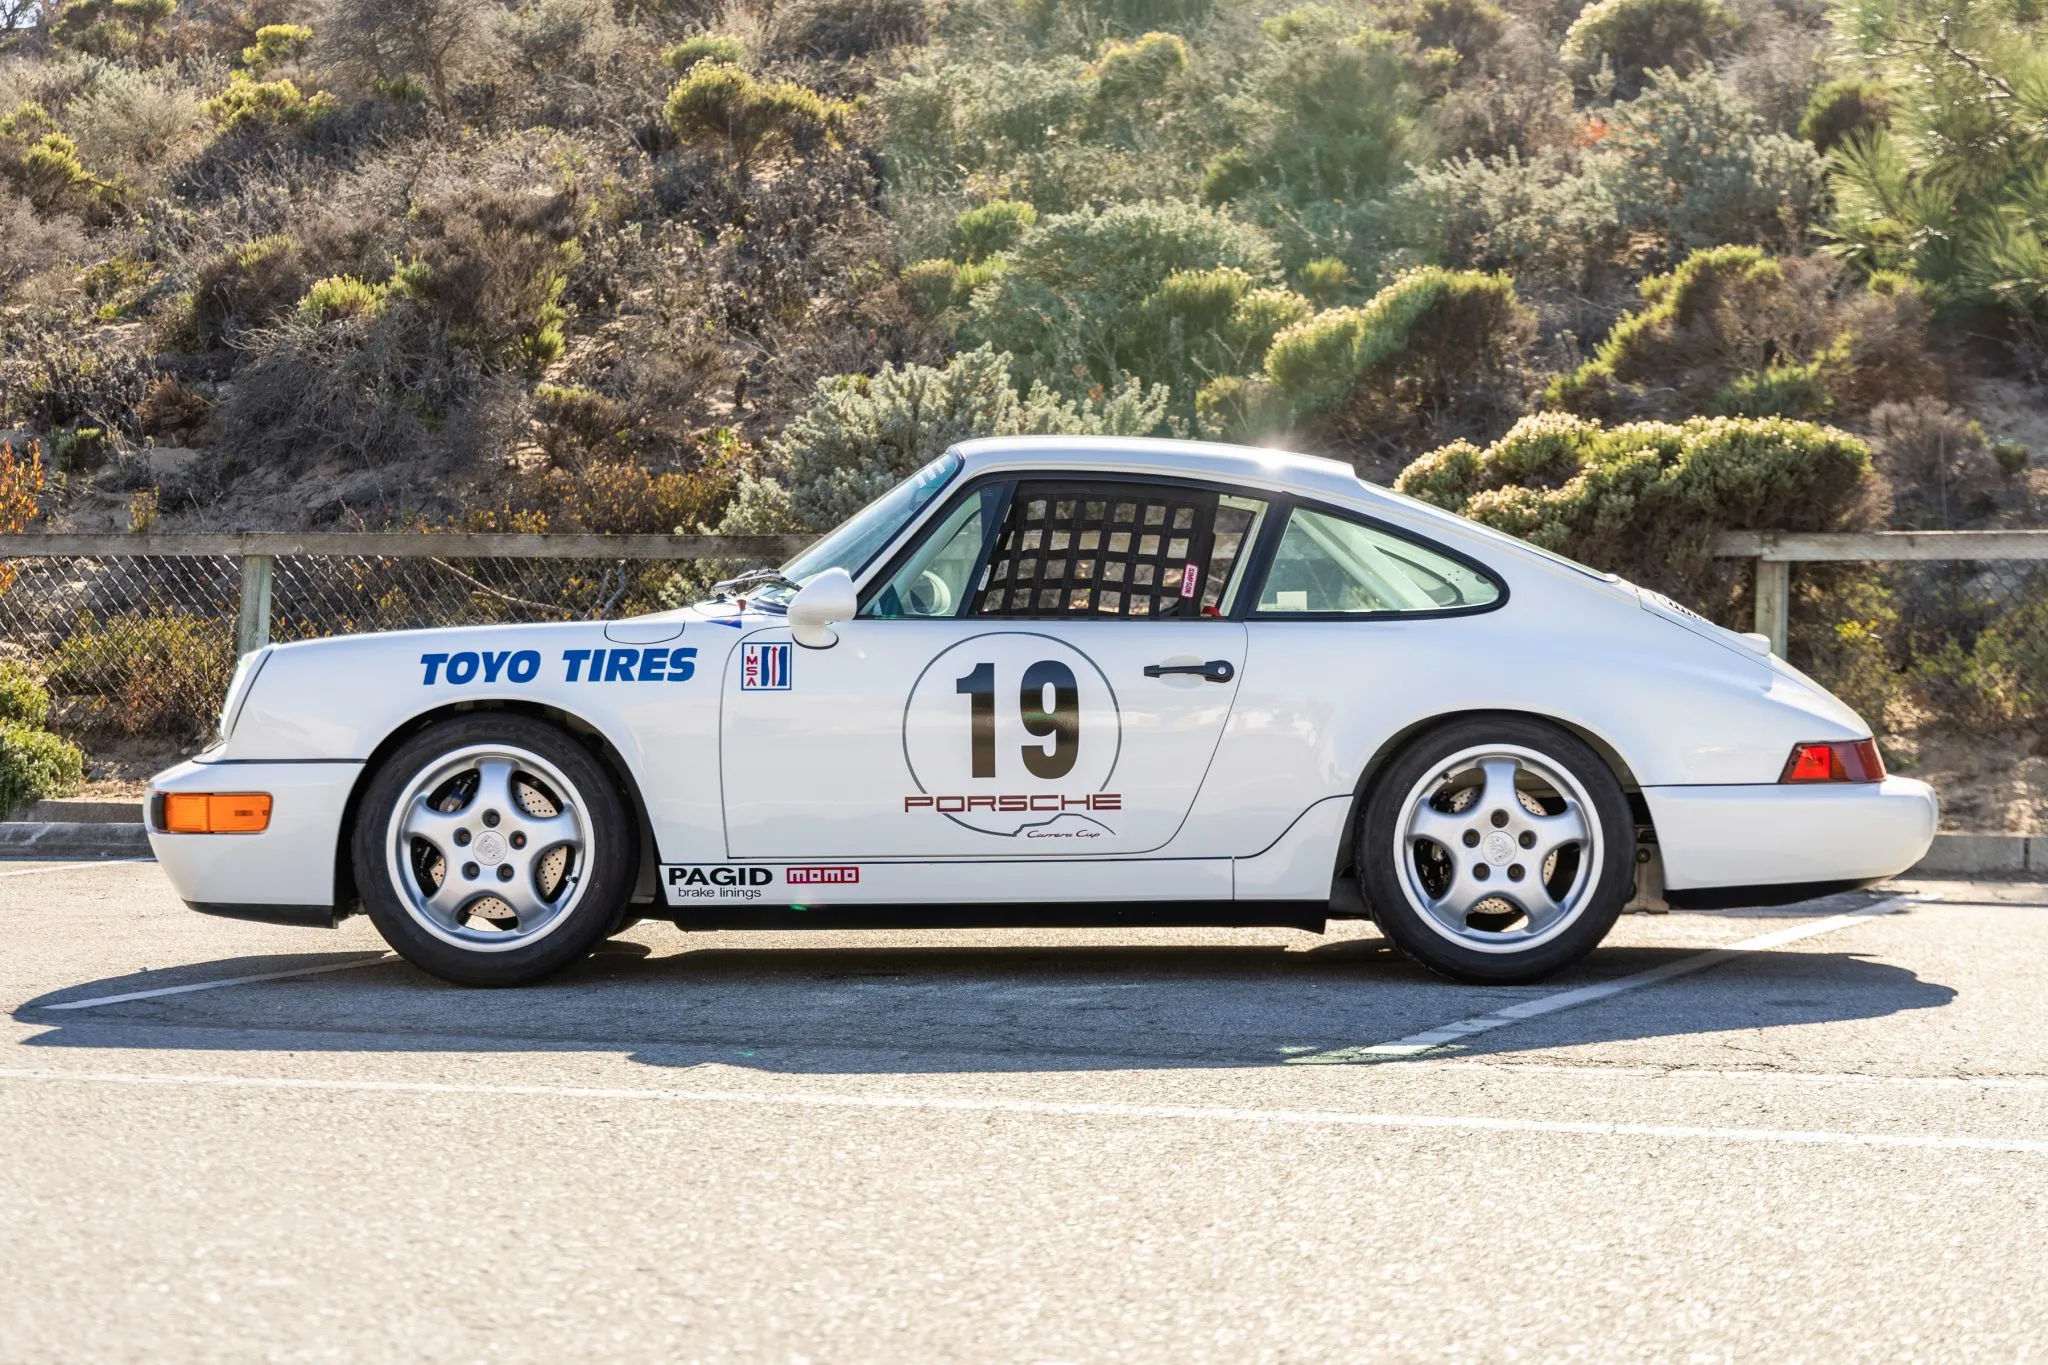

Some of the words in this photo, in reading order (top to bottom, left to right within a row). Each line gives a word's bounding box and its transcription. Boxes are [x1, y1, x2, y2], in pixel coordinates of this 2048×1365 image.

[1184, 567, 1195, 595] SIMPSON
[420, 650, 542, 686] TOYO
[562, 647, 698, 682] TIRES
[746, 645, 758, 687] IMSA
[956, 660, 1080, 780] 19
[904, 793, 1122, 813] PORSCHE
[1027, 829, 1074, 839] Carrera
[1075, 829, 1101, 839] Cup
[668, 867, 773, 886] PAGID
[678, 887, 715, 898] brake
[719, 887, 762, 901] linings
